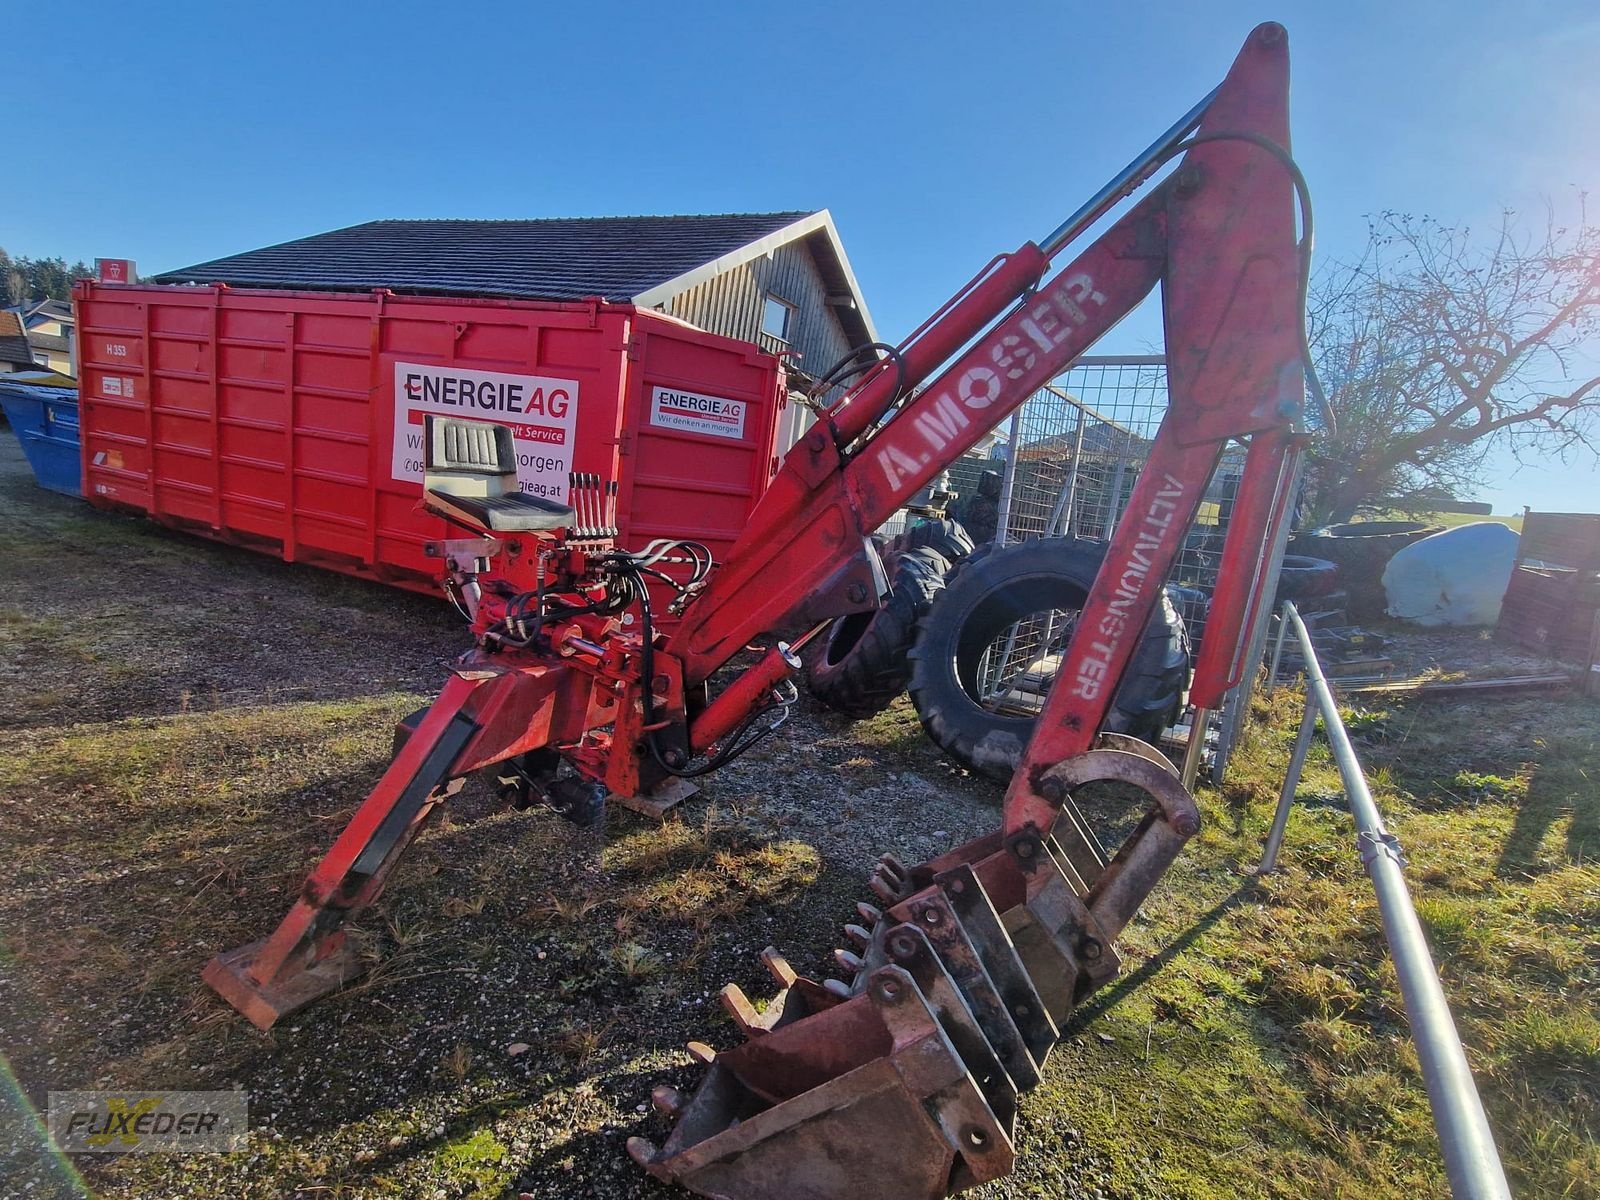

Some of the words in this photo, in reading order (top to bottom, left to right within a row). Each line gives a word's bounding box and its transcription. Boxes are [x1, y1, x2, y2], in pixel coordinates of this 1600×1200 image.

[106, 343, 113, 355] H
[113, 344, 127, 357] 353
[877, 273, 1108, 492] A.MOSER
[404, 373, 524, 413] ENERGIE
[524, 387, 570, 419] AG
[660, 392, 721, 413] ENERGIE
[721, 403, 741, 417] AG
[525, 426, 563, 442] Service
[658, 414, 671, 423] Wir
[672, 416, 700, 427] denken
[711, 423, 739, 434] morgen
[406, 432, 425, 450] Wi
